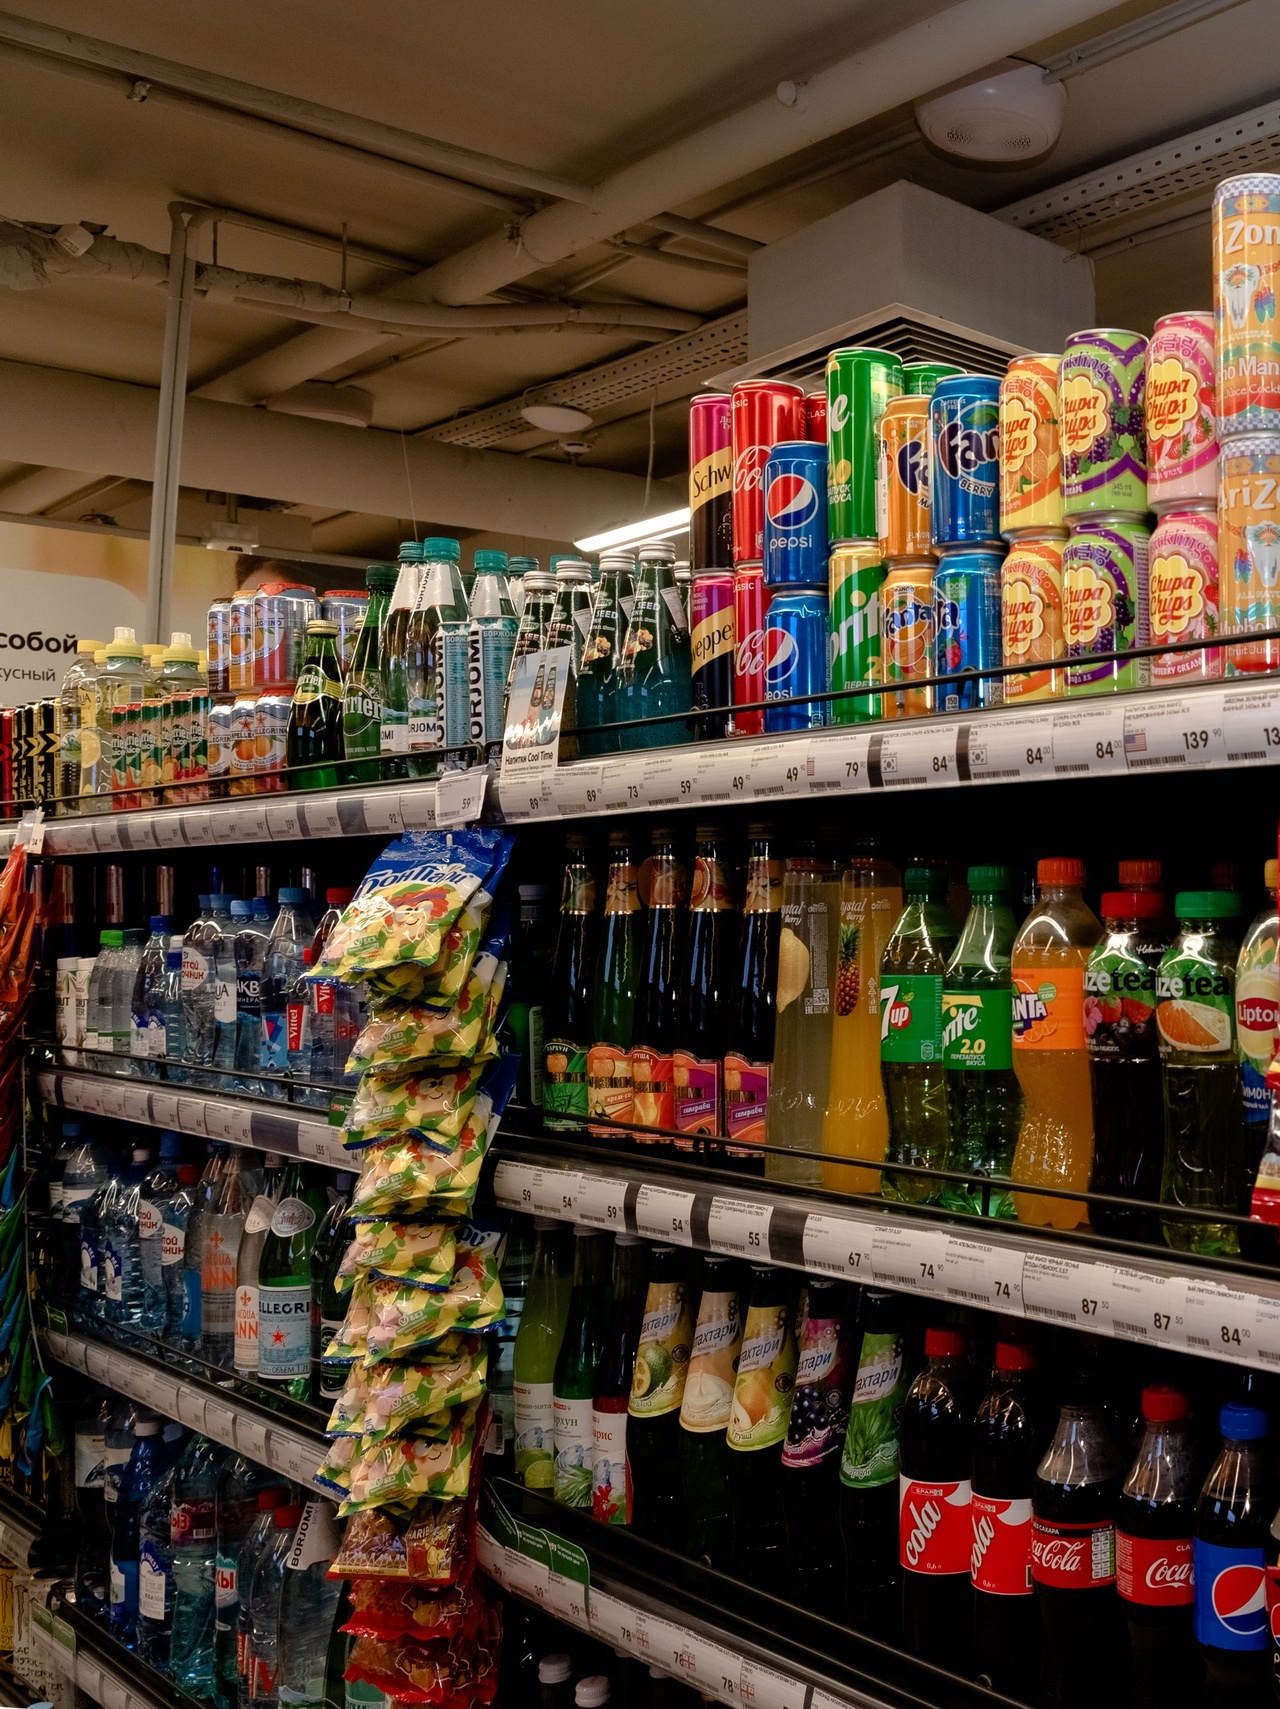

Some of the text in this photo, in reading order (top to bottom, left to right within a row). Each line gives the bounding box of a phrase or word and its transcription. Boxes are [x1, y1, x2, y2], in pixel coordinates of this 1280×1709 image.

[1148, 378, 1190, 399] Chupa
[1225, 384, 1247, 400] Juice
[1148, 398, 1188, 431] Chups
[959, 479, 994, 497] BERRY
[769, 534, 813, 552] pepsi
[414, 568, 431, 611] BORJOMI
[1150, 575, 1196, 594] Chupa
[1063, 586, 1104, 605] Chupa
[596, 610, 618, 620] SEED
[1150, 595, 1192, 625] Chups
[1063, 604, 1101, 636] Chups
[1182, 728, 1221, 750] 139 90
[505, 751, 554, 766] Напитки Cool Time
[1026, 747, 1043, 764] 84
[1096, 741, 1114, 759] 84
[845, 762, 859, 777] 79
[932, 755, 947, 772] 84
[732, 776, 744, 790] 49
[786, 767, 798, 782] 49
[586, 789, 597, 802] 89
[628, 785, 639, 799] 73
[680, 780, 691, 794] 59
[462, 798, 471, 809] 59
[529, 798, 539, 810] 89
[289, 1008, 299, 1039] Vittel
[960, 1039, 986, 1054] 2.0
[683, 1102, 711, 1115] саперави
[735, 1107, 764, 1119] саперави
[523, 1189, 531, 1201] 59
[563, 1196, 572, 1209] 54
[607, 1206, 617, 1218] 59
[673, 1218, 683, 1232] 54
[748, 1232, 760, 1246] 55
[848, 1252, 861, 1267] 67
[920, 1262, 935, 1279] 74
[994, 1281, 1011, 1299] 74
[1082, 1298, 1110, 1316] 87 50
[1154, 1313, 1184, 1331] 87 50
[1221, 1326, 1241, 1345] 84
[291, 1503, 314, 1568] BORJOMI
[906, 1500, 942, 1566] cola
[1039, 1524, 1060, 1535] САХАРА
[971, 1515, 995, 1581] cola
[620, 1626, 632, 1643] 78
[673, 1650, 684, 1665] 78
[721, 1675, 734, 1693] 78
